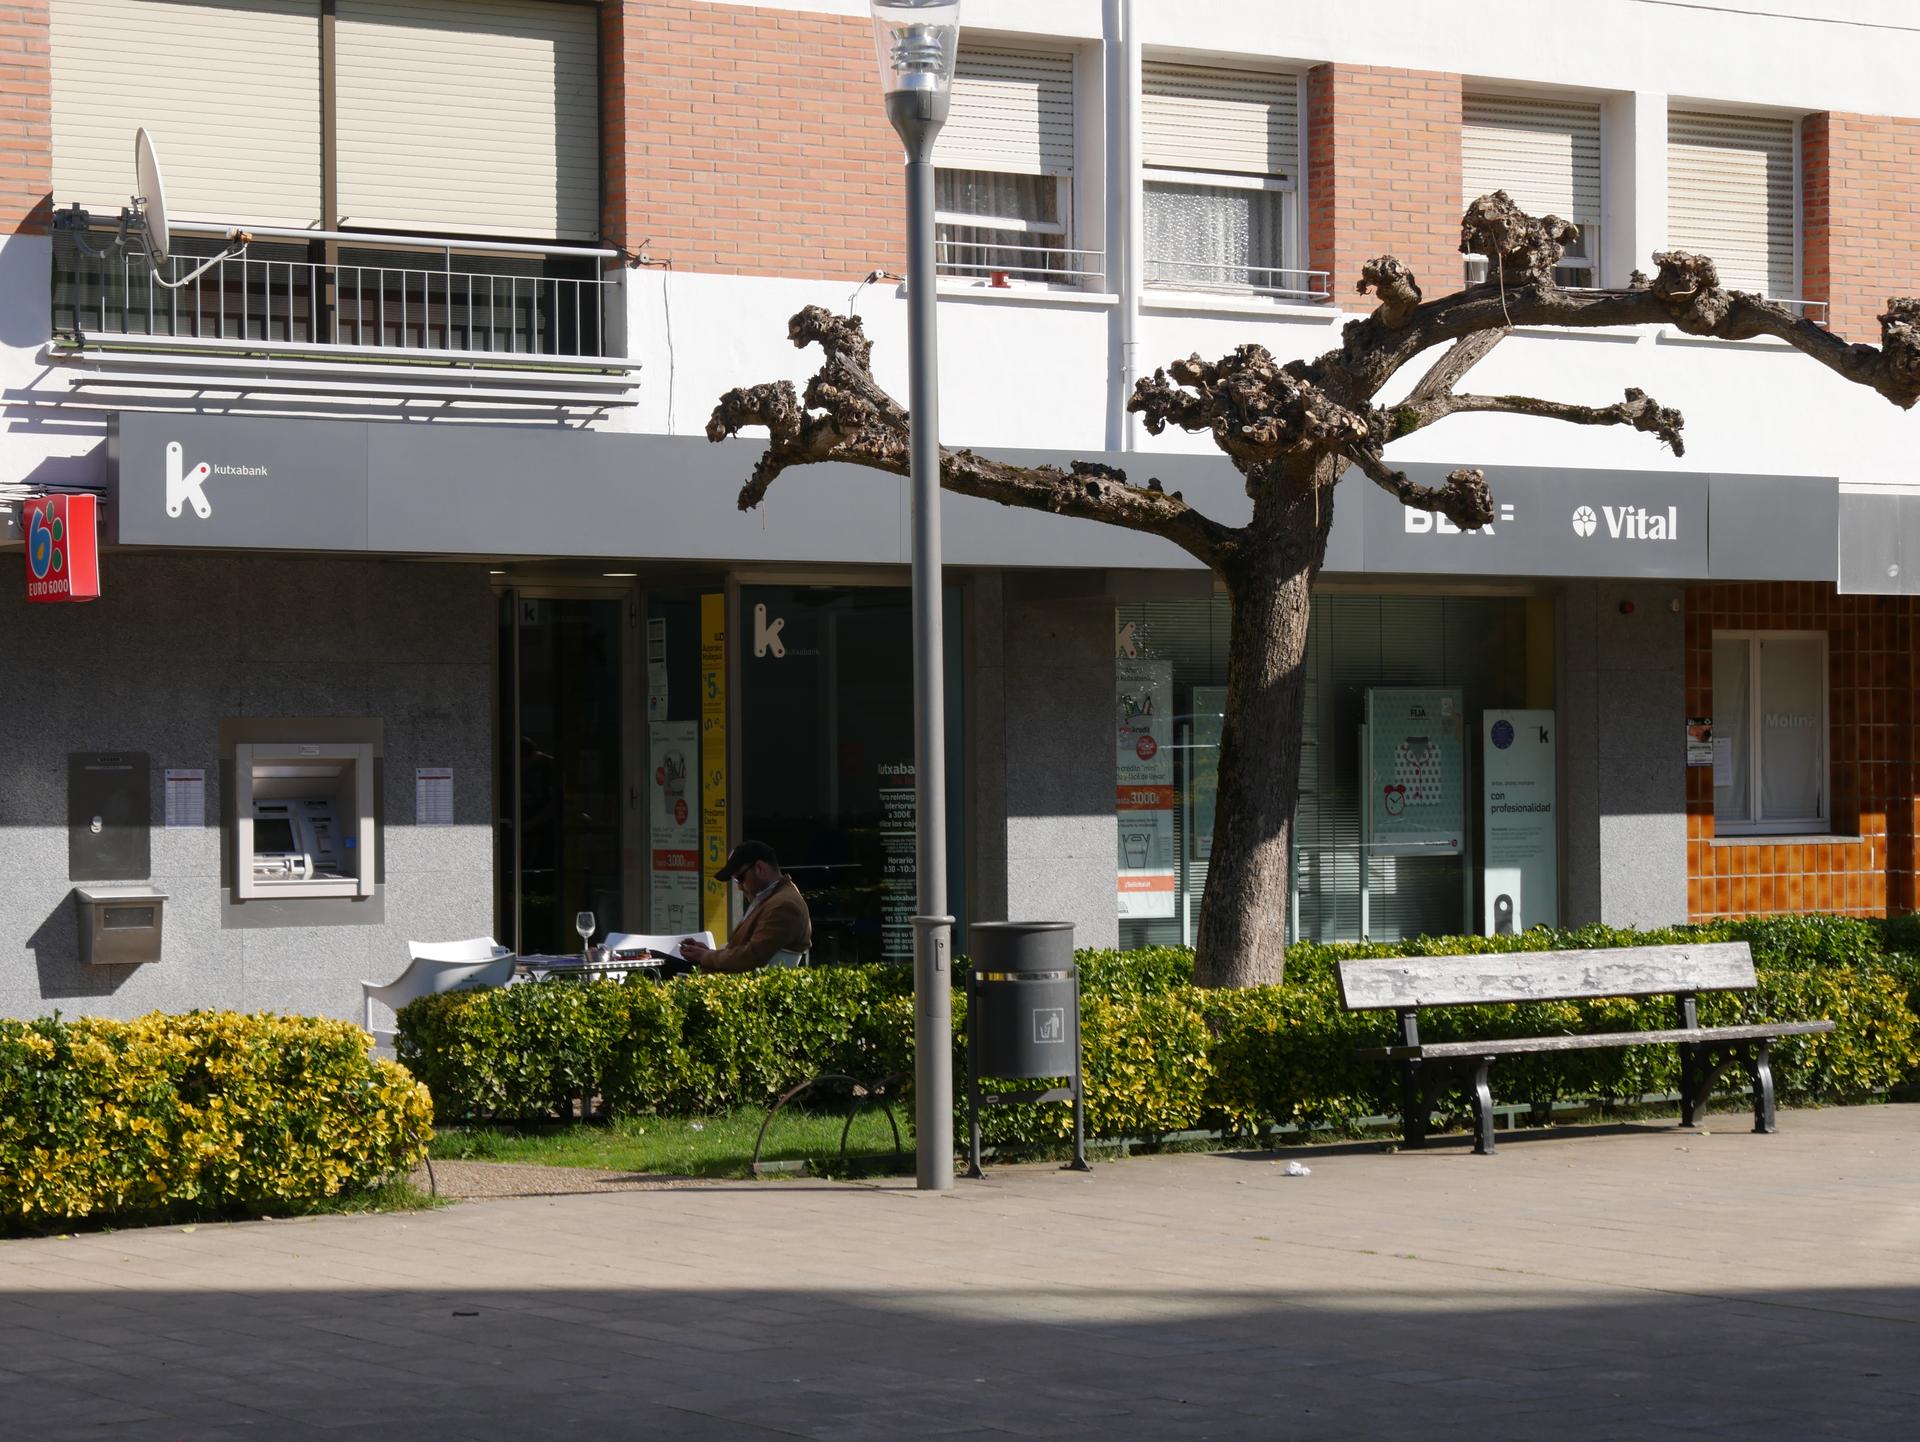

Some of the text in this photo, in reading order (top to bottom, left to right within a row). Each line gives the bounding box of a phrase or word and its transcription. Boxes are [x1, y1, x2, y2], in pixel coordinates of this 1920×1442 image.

[213, 463, 268, 477] kutxabank
[165, 441, 212, 518] k
[1601, 505, 1677, 540] Vital
[29, 578, 69, 596] EURO 6000
[753, 602, 785, 658] k
[1490, 792, 1505, 801] con
[1491, 802, 1552, 816] profesionalidad
